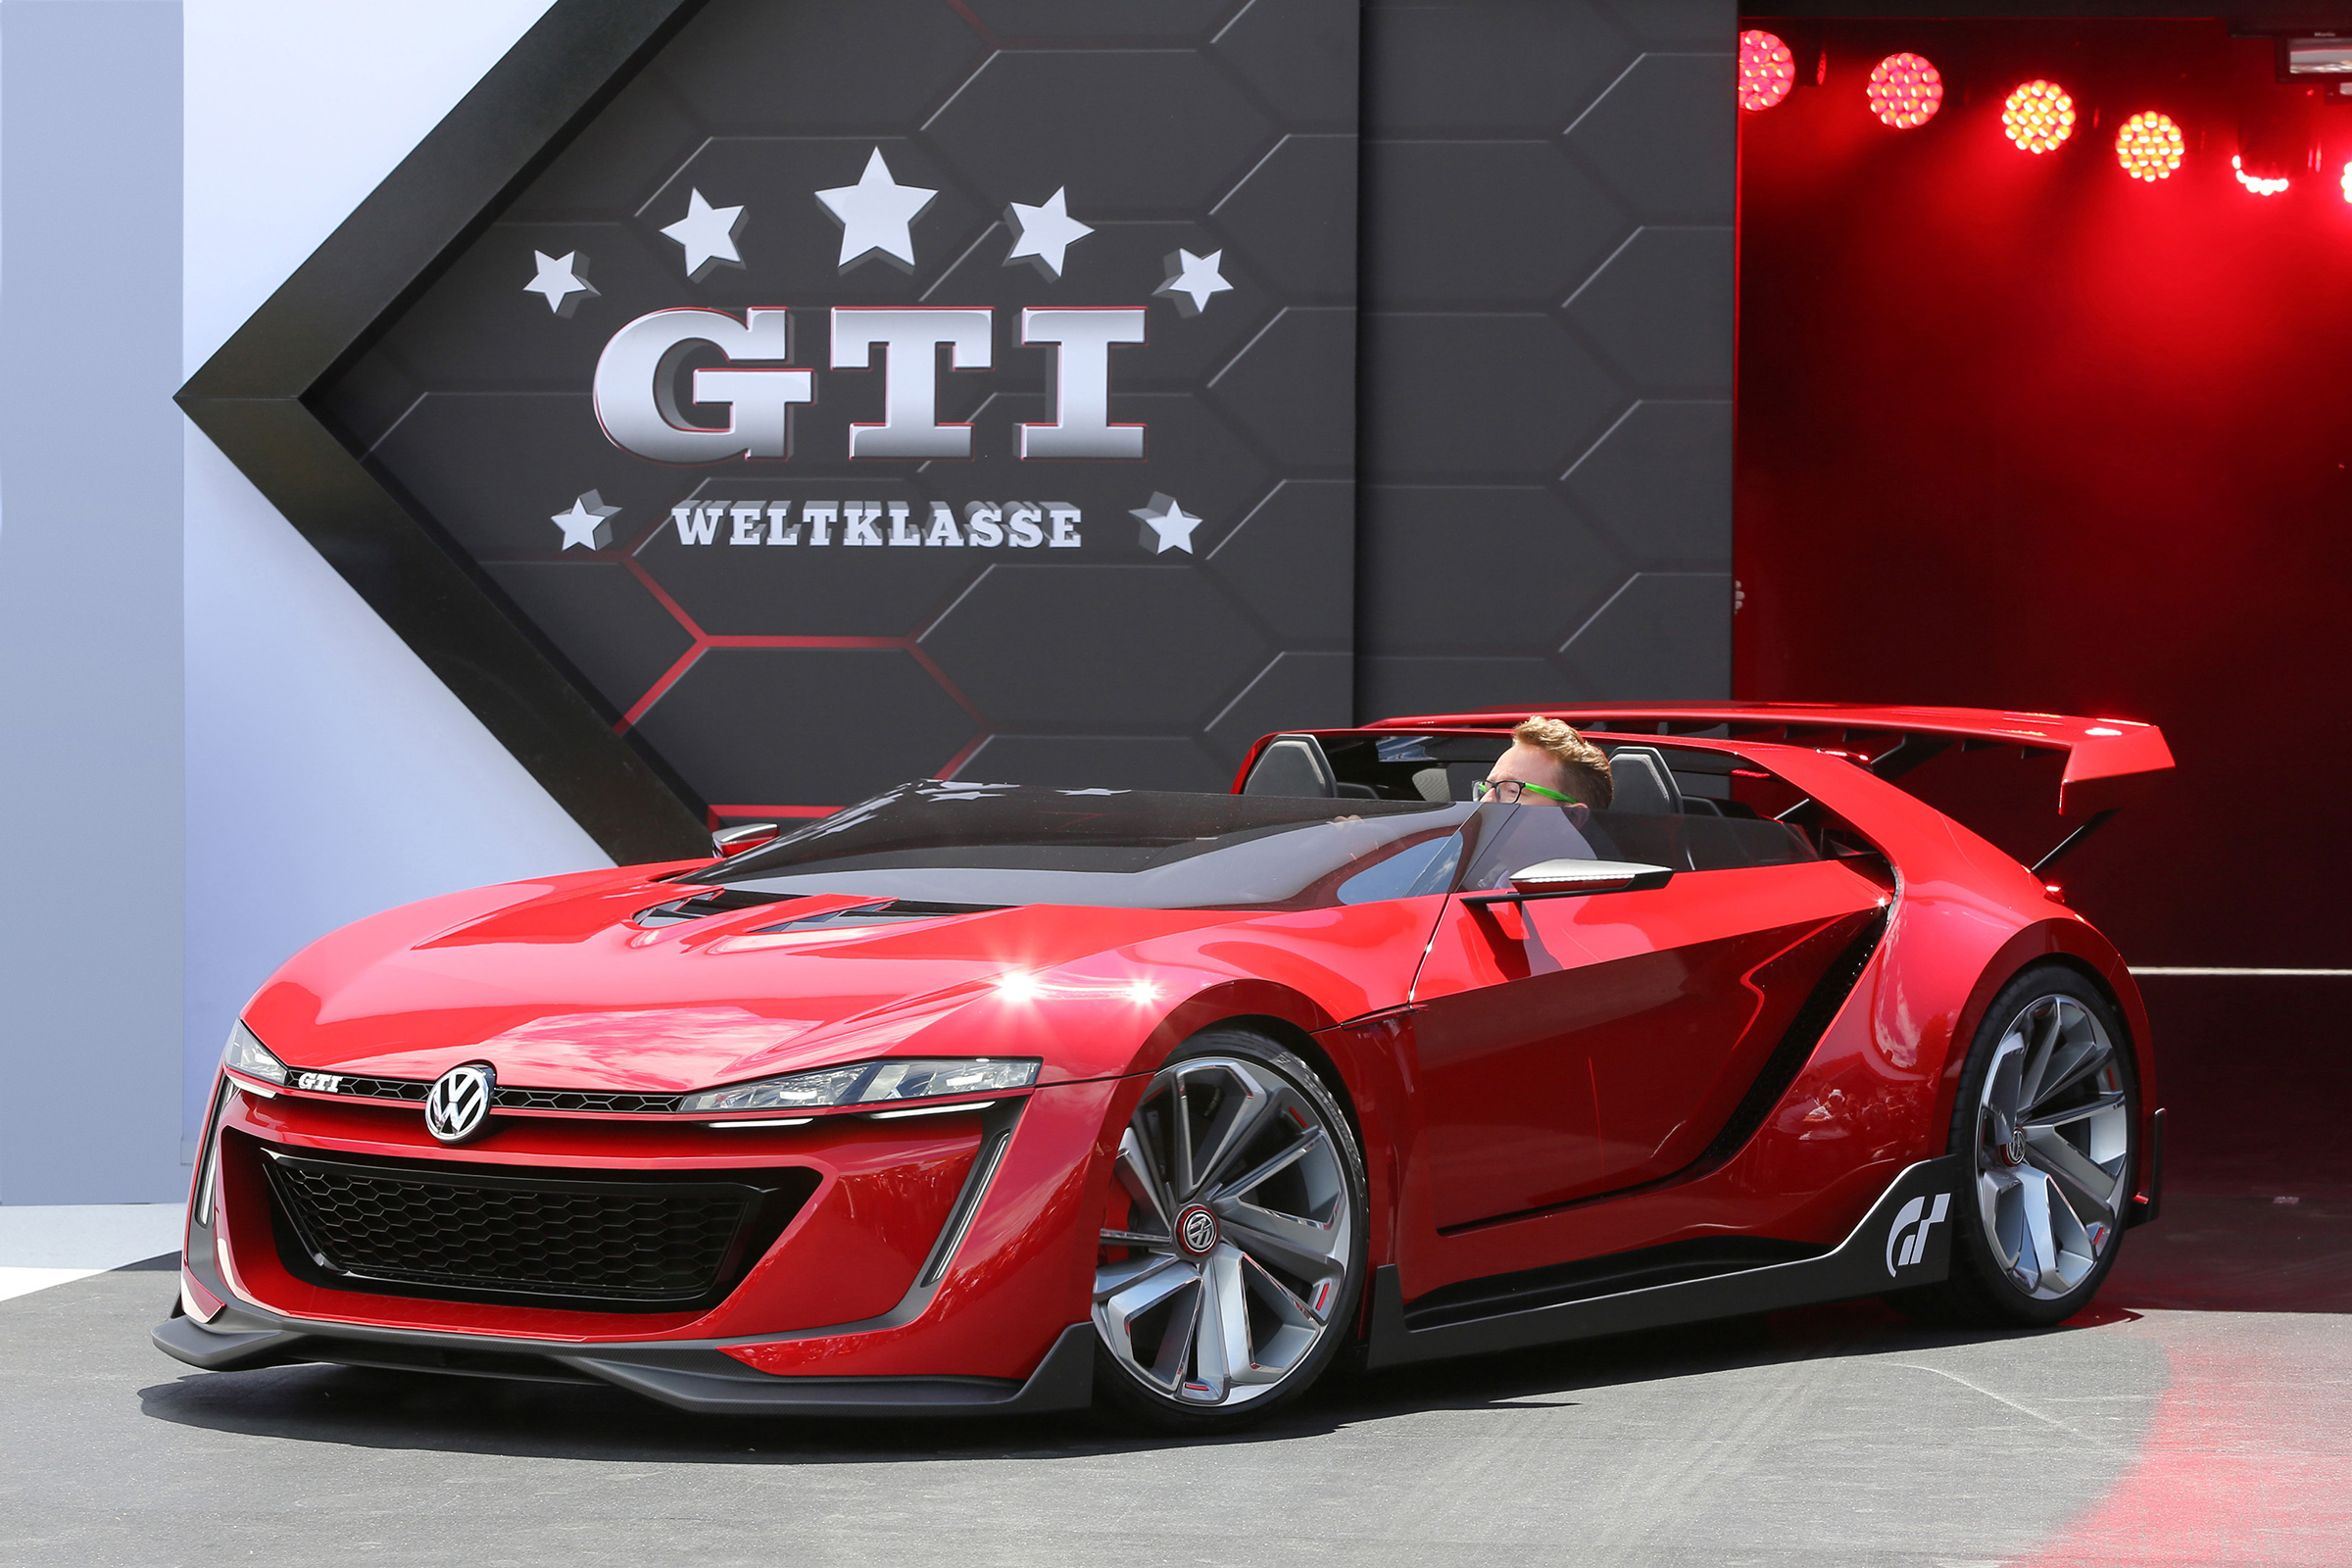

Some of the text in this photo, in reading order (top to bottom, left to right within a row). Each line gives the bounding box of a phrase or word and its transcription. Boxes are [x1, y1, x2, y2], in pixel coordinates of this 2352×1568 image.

[593, 307, 1148, 463] GTI
[671, 503, 1082, 548] WELTKLASSE
[298, 1072, 343, 1093] GTI
[426, 1064, 490, 1143] VW
